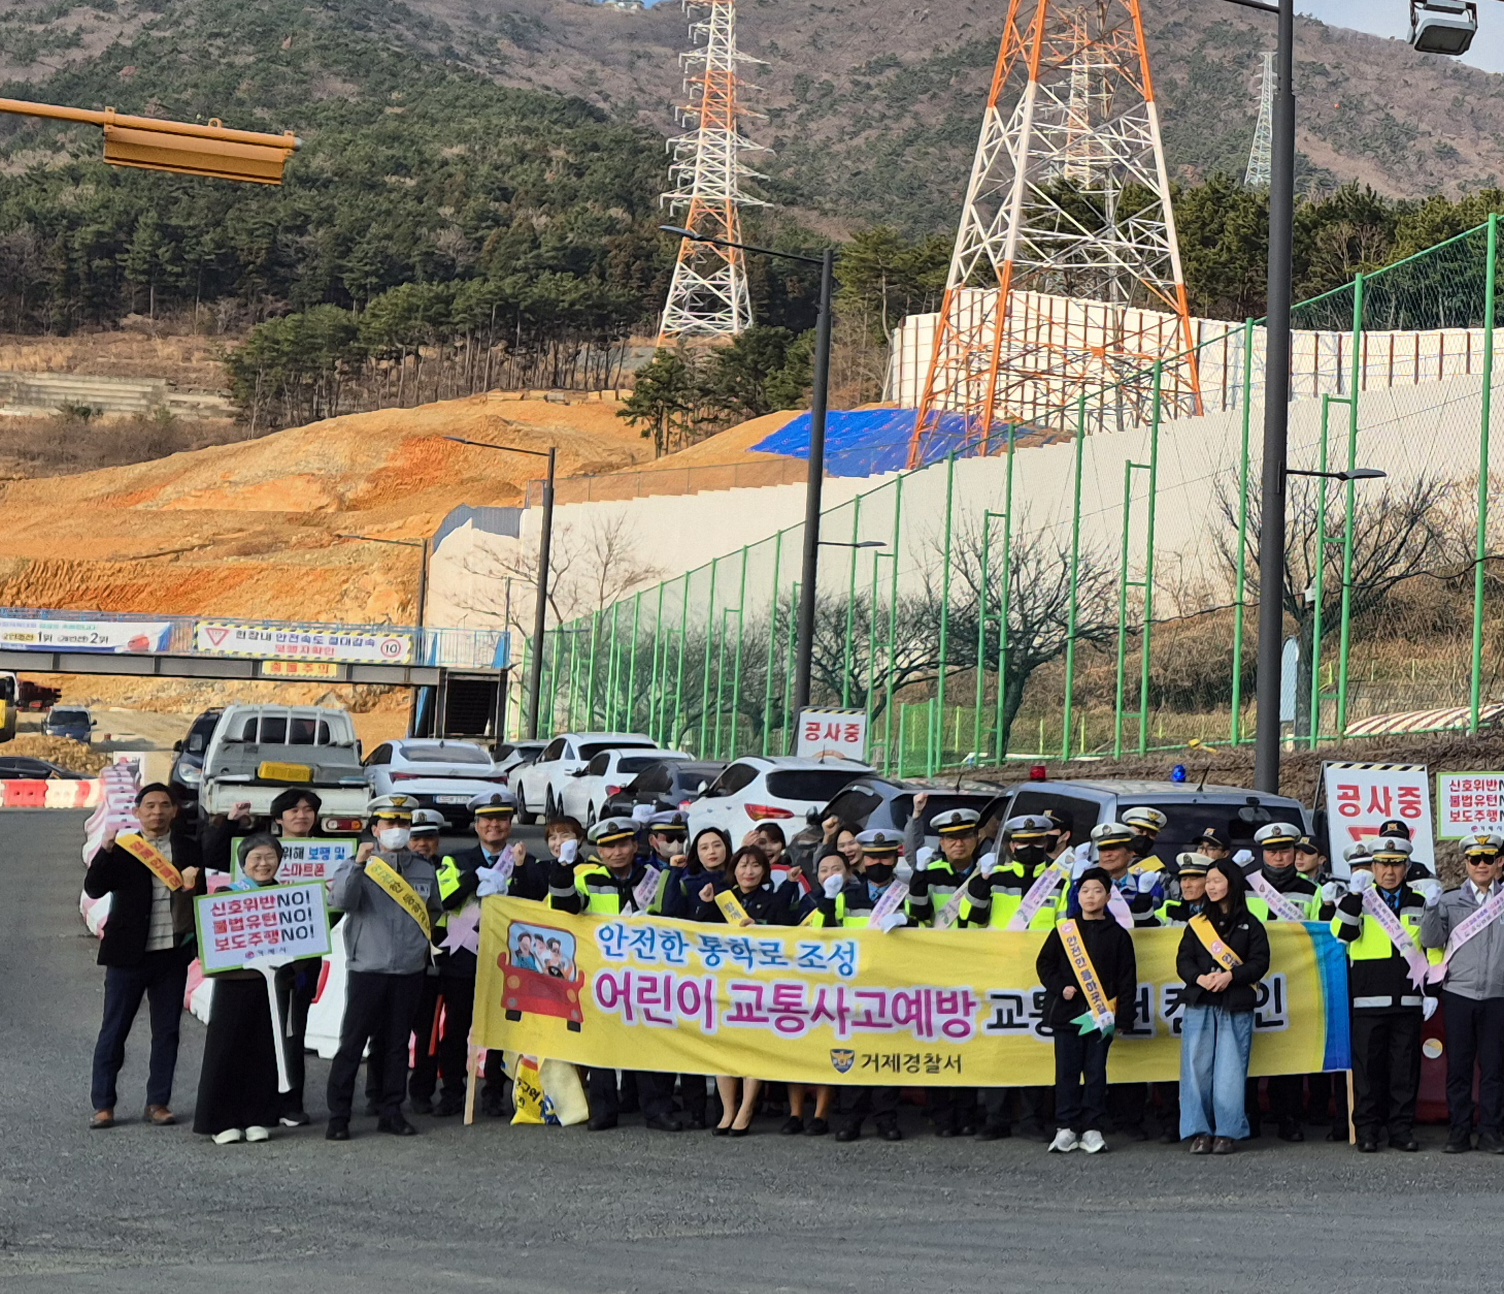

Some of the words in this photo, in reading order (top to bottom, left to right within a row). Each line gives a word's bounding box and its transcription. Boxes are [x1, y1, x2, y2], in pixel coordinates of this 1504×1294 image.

[276, 632, 324, 645] 안전속도
[385, 643, 397, 654] 10
[805, 721, 860, 743] 공사중
[1337, 784, 1422, 819] 공사중
[308, 846, 331, 860] 보행
[334, 846, 346, 860] 및
[280, 862, 326, 877] 스마트폰
[210, 889, 311, 918] 신호위반NO!
[212, 906, 313, 935] 불법유턴NO!
[214, 924, 315, 952] 보도주행NO!
[598, 922, 690, 964] 안전한
[697, 933, 789, 970] 통학로
[797, 941, 856, 977] 조성
[595, 970, 713, 1030] 어린이
[726, 983, 977, 1038] 교통사고예방
[860, 1051, 964, 1075] 거제경찰서
